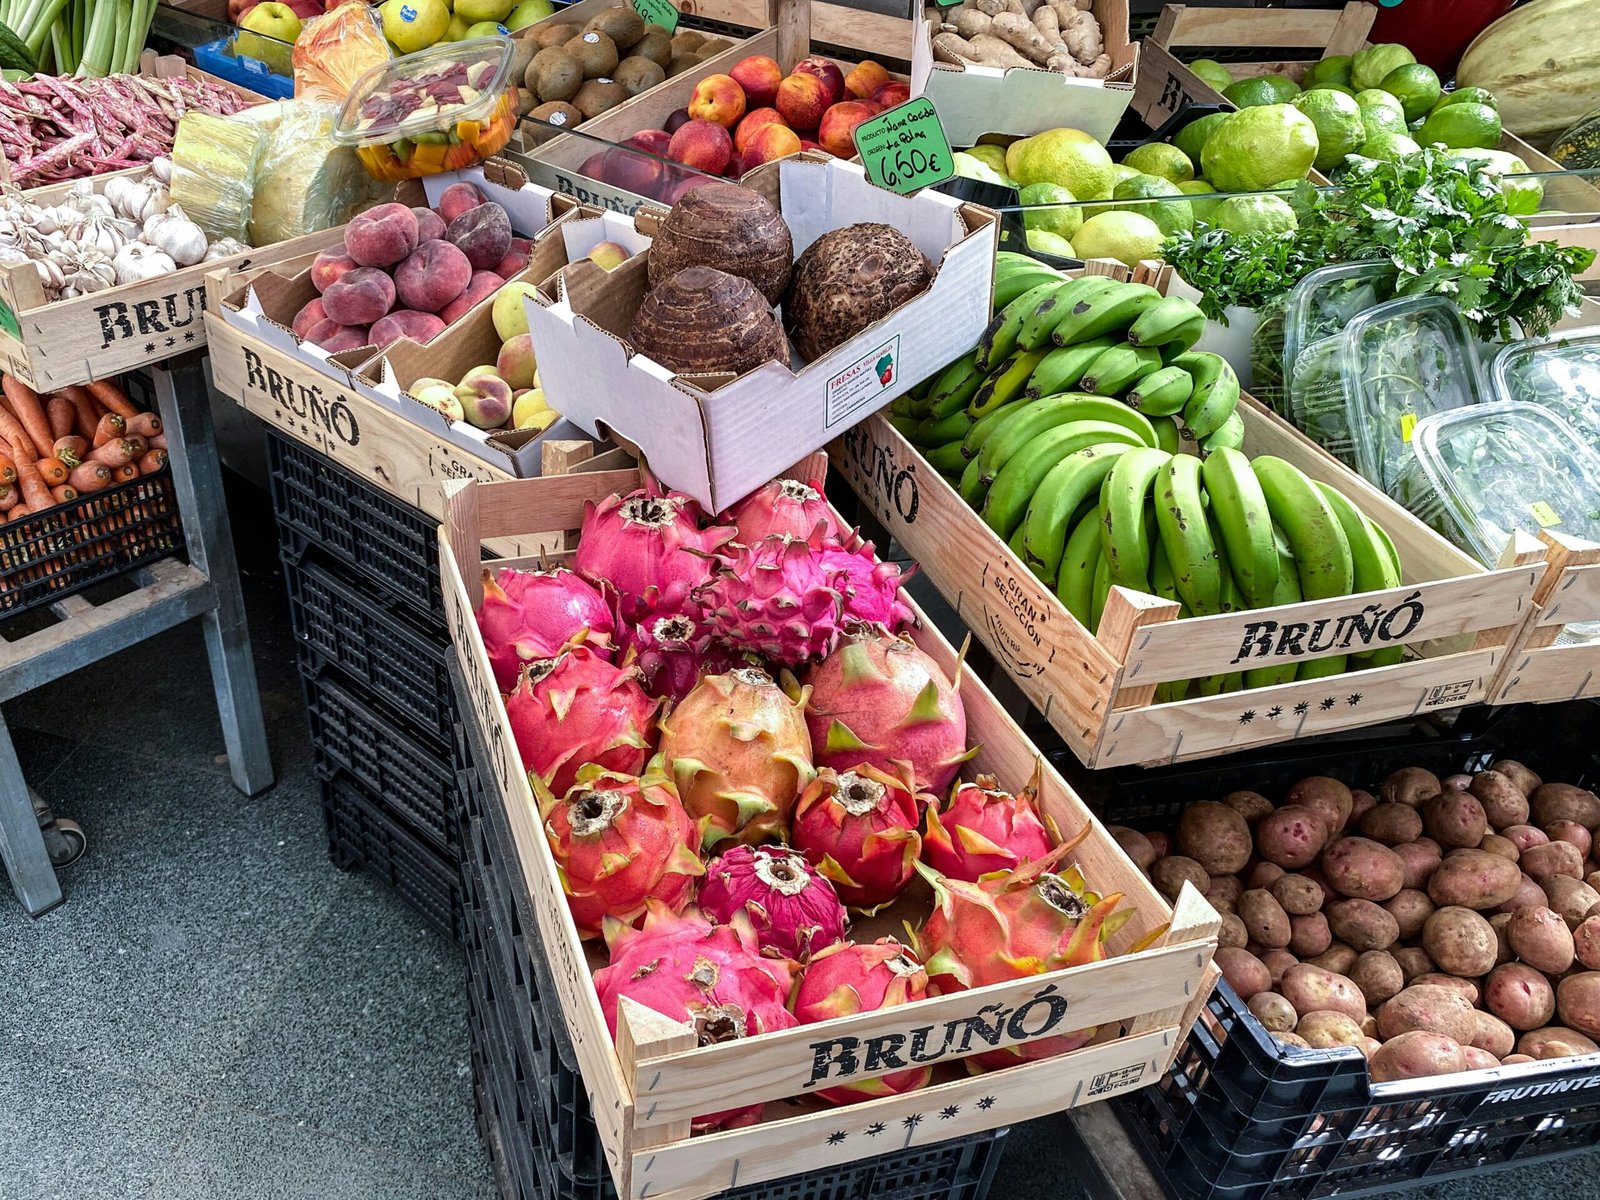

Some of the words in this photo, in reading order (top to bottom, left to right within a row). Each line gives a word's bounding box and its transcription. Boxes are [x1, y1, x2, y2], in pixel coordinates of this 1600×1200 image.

[881, 149, 941, 187] 6,50€
[241, 346, 360, 446] BRUÑÓ
[831, 365, 861, 390] FRESAS
[1007, 577, 1037, 622] GRAN
[1230, 590, 1424, 664] BRUÑÓ
[803, 984, 1068, 1088] BRUÑÓ
